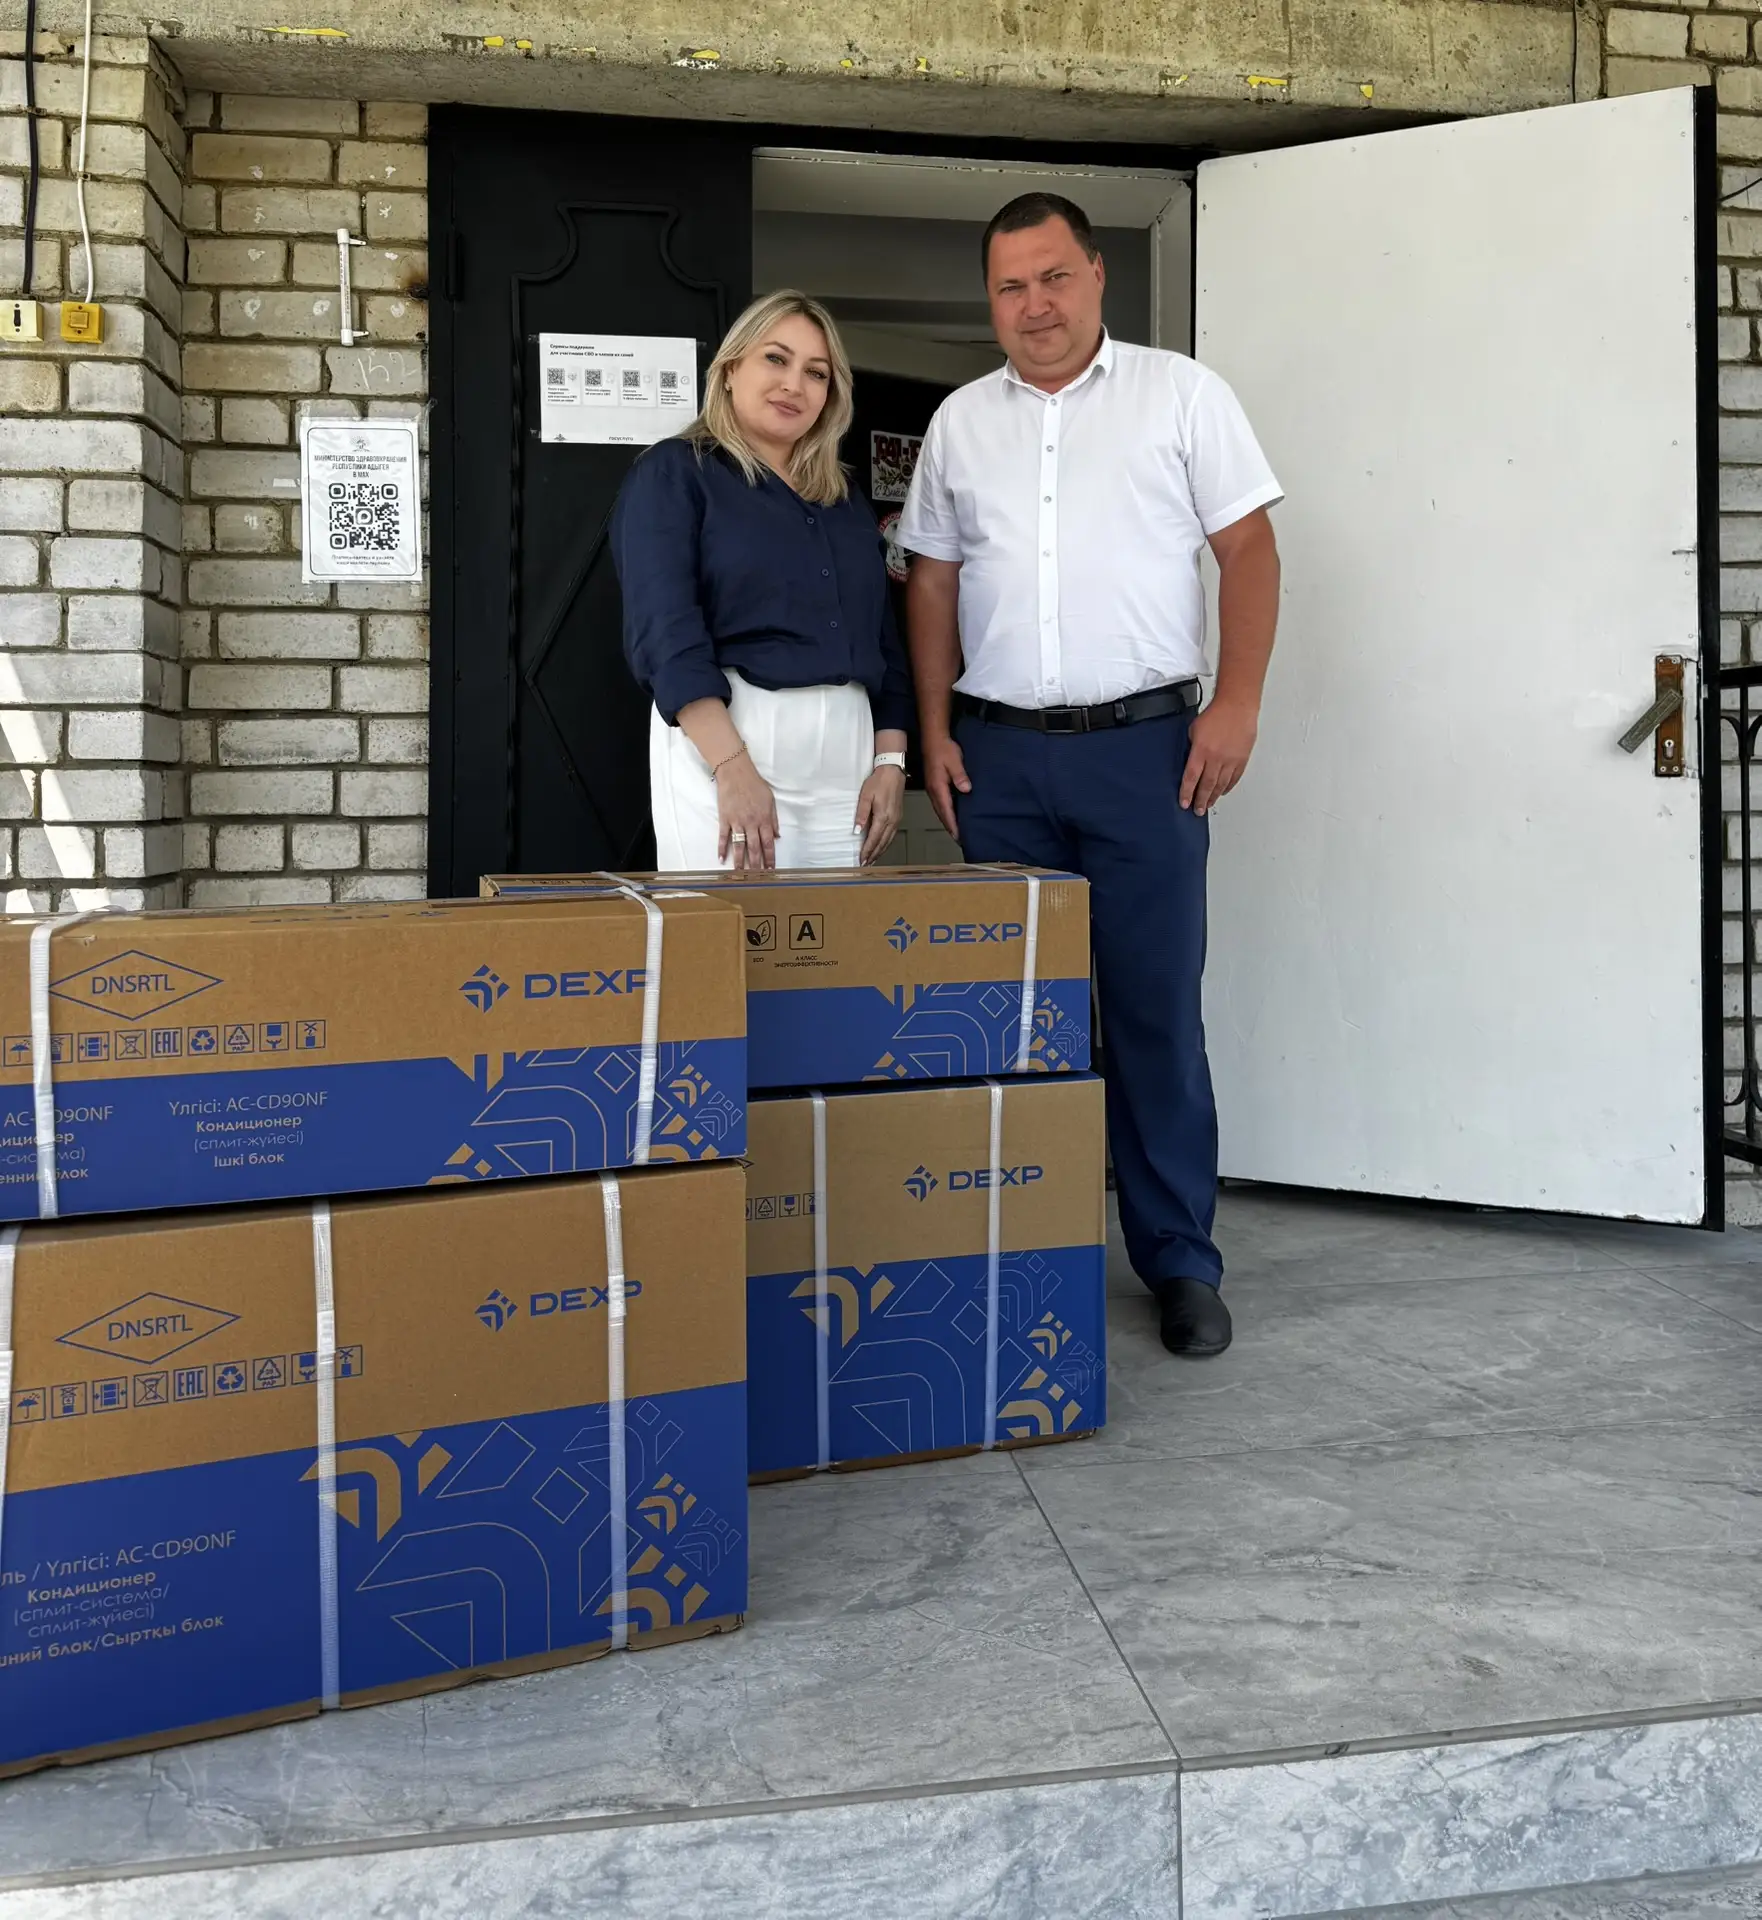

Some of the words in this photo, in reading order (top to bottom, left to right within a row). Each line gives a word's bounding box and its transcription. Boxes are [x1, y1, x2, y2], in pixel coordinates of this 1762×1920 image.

[367, 463, 390, 471] АДЫГЕЯ
[796, 919, 817, 942] A
[928, 922, 1024, 944] DEXP
[91, 974, 176, 996] DNSRTL
[524, 968, 653, 1000] DEXP
[155, 1031, 179, 1054] EAC
[196, 1116, 302, 1133] Кондиционер
[214, 1153, 245, 1168] Ішкі
[249, 1152, 285, 1165] блок
[948, 1165, 1044, 1191] DEXP
[530, 1280, 643, 1317] DEXP
[108, 1312, 194, 1342] DNSRTL
[177, 1369, 204, 1397] EAC
[27, 1571, 157, 1604] Кондиционер
[181, 1615, 225, 1633] блок
